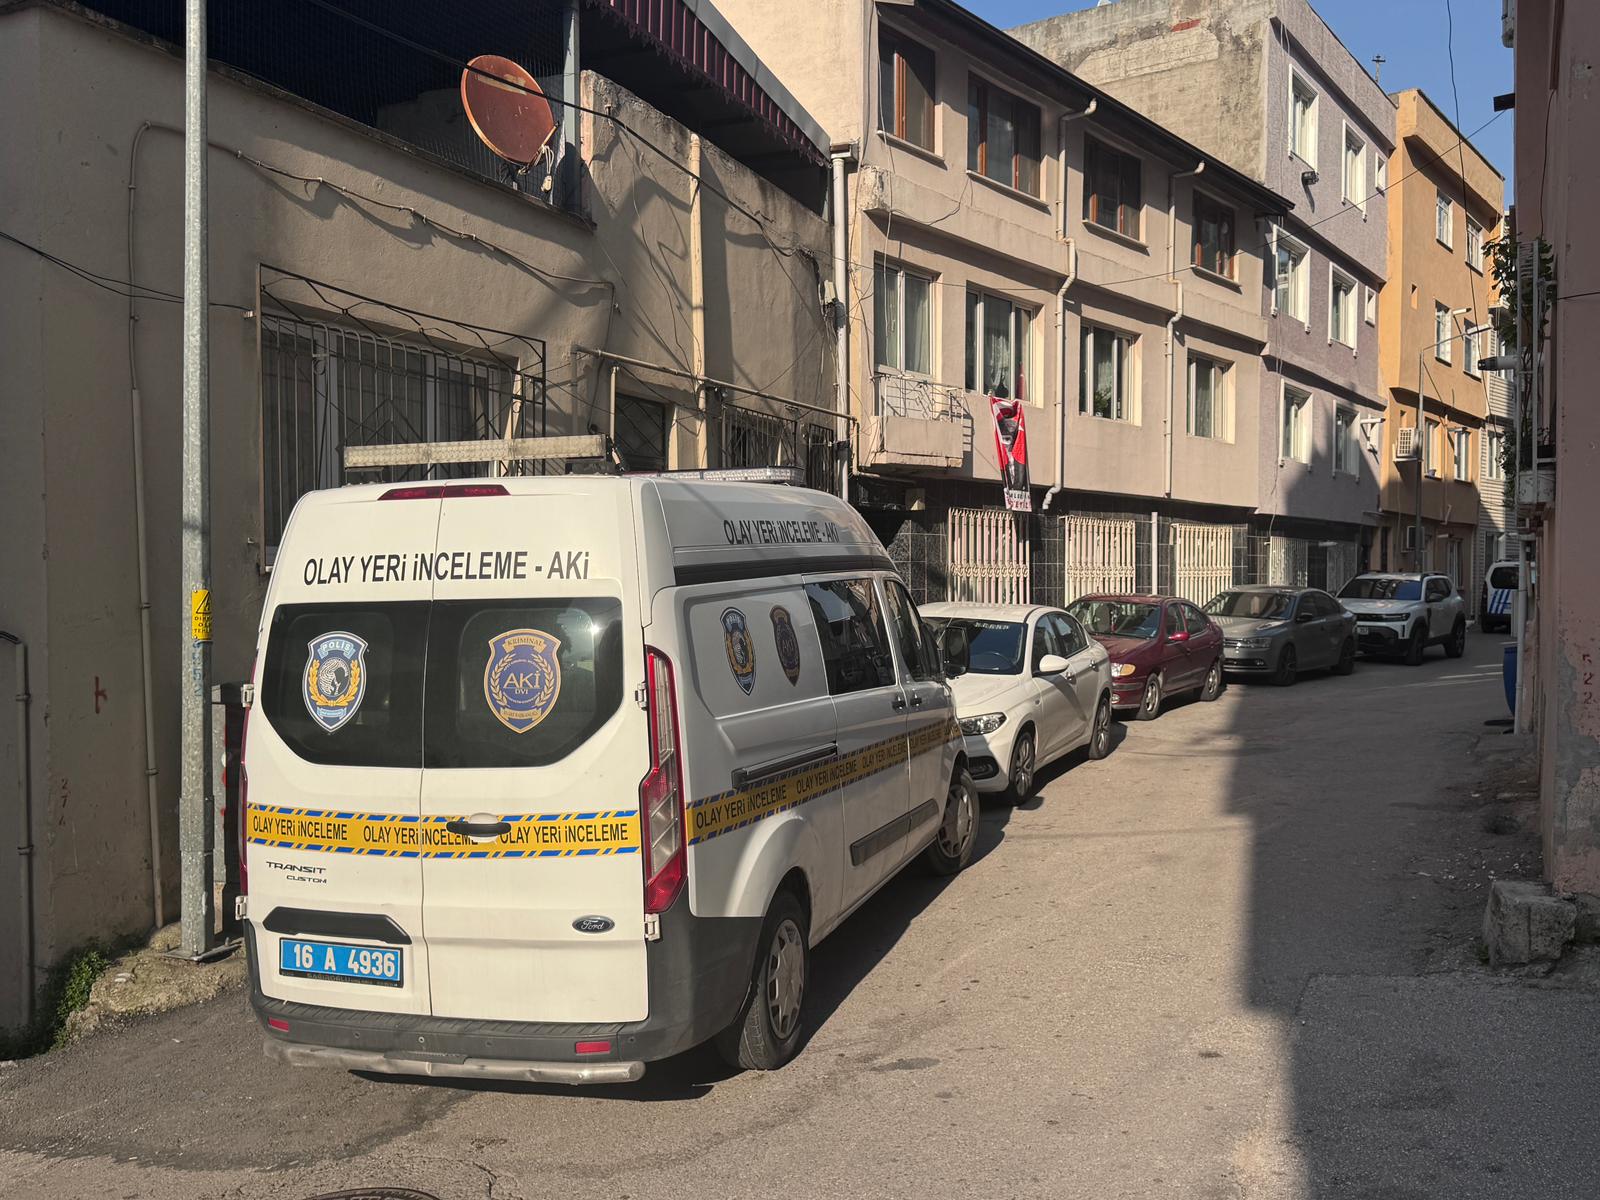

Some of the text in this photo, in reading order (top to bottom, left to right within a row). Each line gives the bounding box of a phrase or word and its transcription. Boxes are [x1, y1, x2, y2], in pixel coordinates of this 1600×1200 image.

[723, 519, 753, 545] OLAY
[303, 556, 354, 586] OLAY
[696, 806, 722, 829] OLAY
[796, 776, 816, 794] OLAY
[253, 815, 273, 833] OLAY
[363, 825, 392, 843] OLAY
[266, 861, 326, 874] TRANSIT
[286, 874, 327, 884] CUSTOM
[580, 919, 605, 930] Ford
[293, 943, 396, 977] 16 A 4936
